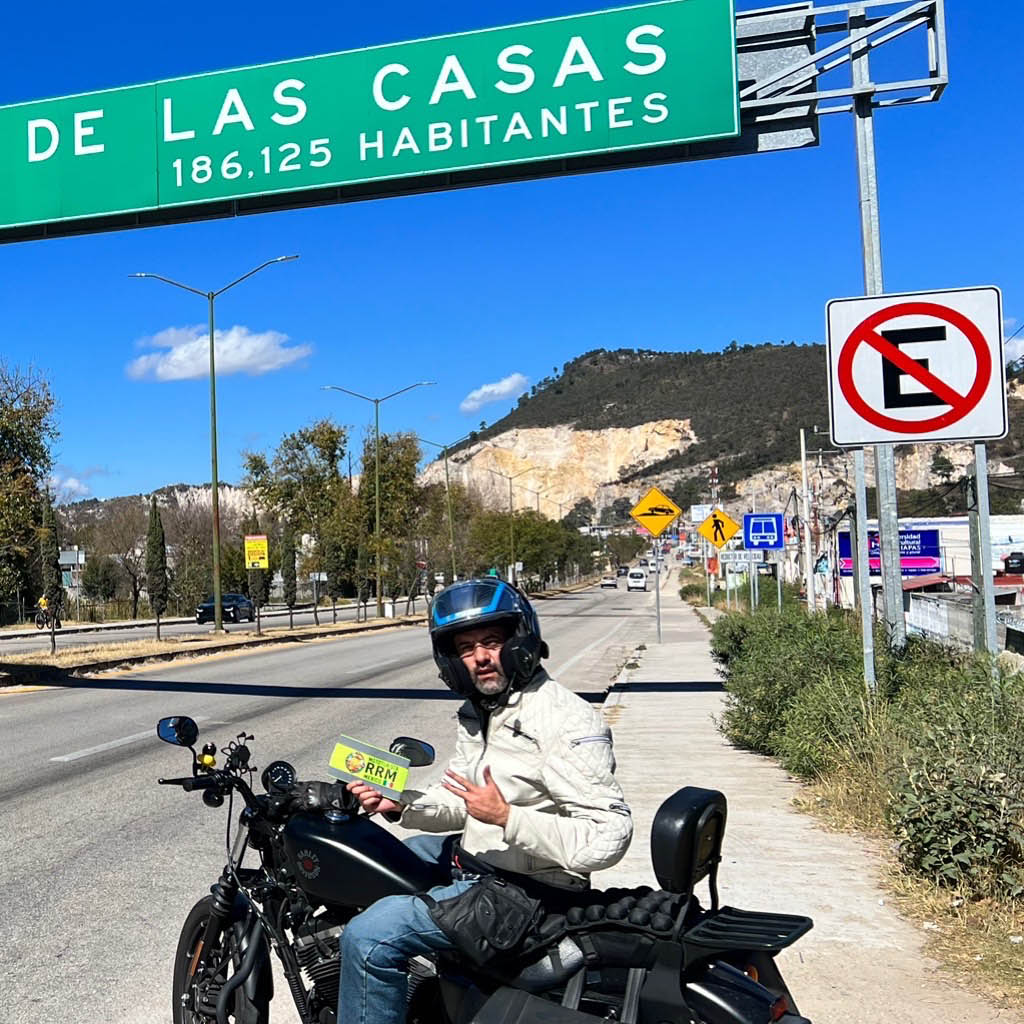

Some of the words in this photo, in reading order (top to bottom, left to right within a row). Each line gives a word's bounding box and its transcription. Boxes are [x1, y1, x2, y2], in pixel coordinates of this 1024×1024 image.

[27, 109, 105, 163] DE
[162, 79, 309, 142] LAS
[372, 25, 668, 111] CASAS
[172, 138, 332, 187] 186,125
[358, 92, 669, 161] HABITANTES
[365, 762, 398, 783] RRM
